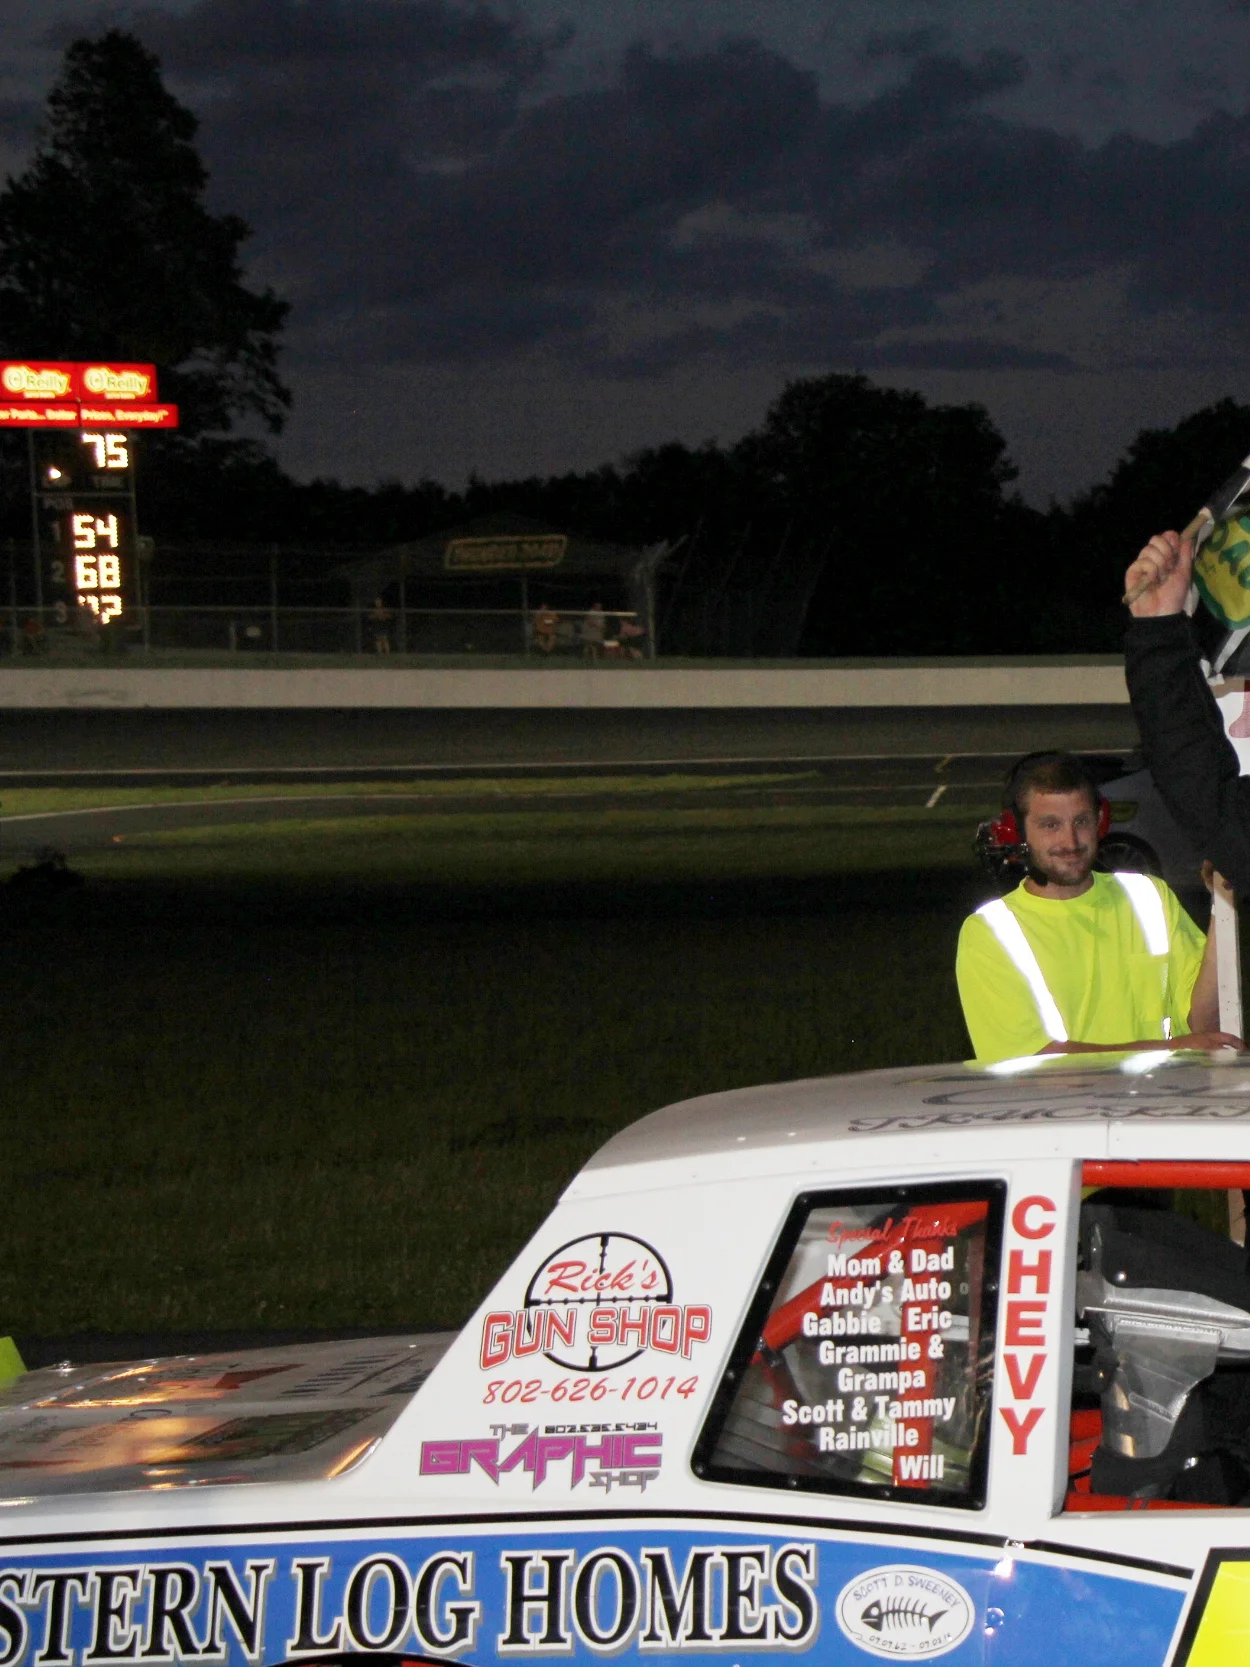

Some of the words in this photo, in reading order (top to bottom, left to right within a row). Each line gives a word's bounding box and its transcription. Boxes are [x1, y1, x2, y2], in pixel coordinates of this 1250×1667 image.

[82, 433, 128, 468] 75
[73, 514, 118, 548] 54
[75, 555, 121, 589] 68
[544, 1259, 660, 1294] Rick's
[827, 1253, 881, 1277] Mom
[888, 1250, 904, 1274] &
[911, 1246, 954, 1273] Dad
[820, 1280, 893, 1309] Andy's
[900, 1277, 951, 1303] Auto
[480, 1309, 578, 1370] GUN
[588, 1304, 712, 1360] SHOP
[803, 1310, 882, 1337] Gabbie
[908, 1306, 952, 1331] Eric
[999, 1195, 1057, 1456] CHEVY
[819, 1336, 921, 1365] Grammie
[928, 1334, 944, 1358] &
[483, 1376, 699, 1404] 802-626-1014
[838, 1367, 926, 1394] Grampa
[782, 1399, 844, 1424] Scott
[851, 1396, 868, 1421] &
[875, 1396, 956, 1421] Tammy
[489, 1423, 530, 1441] THE
[819, 1423, 919, 1451] Rainville
[419, 1425, 663, 1493] GRAPHIC
[900, 1454, 944, 1480] Will
[588, 1470, 660, 1494] SHOP
[287, 1551, 481, 1655] LOG
[497, 1544, 818, 1652] HOMES
[853, 1577, 888, 1601] SCOTT
[908, 1575, 960, 1608] SWEENEY
